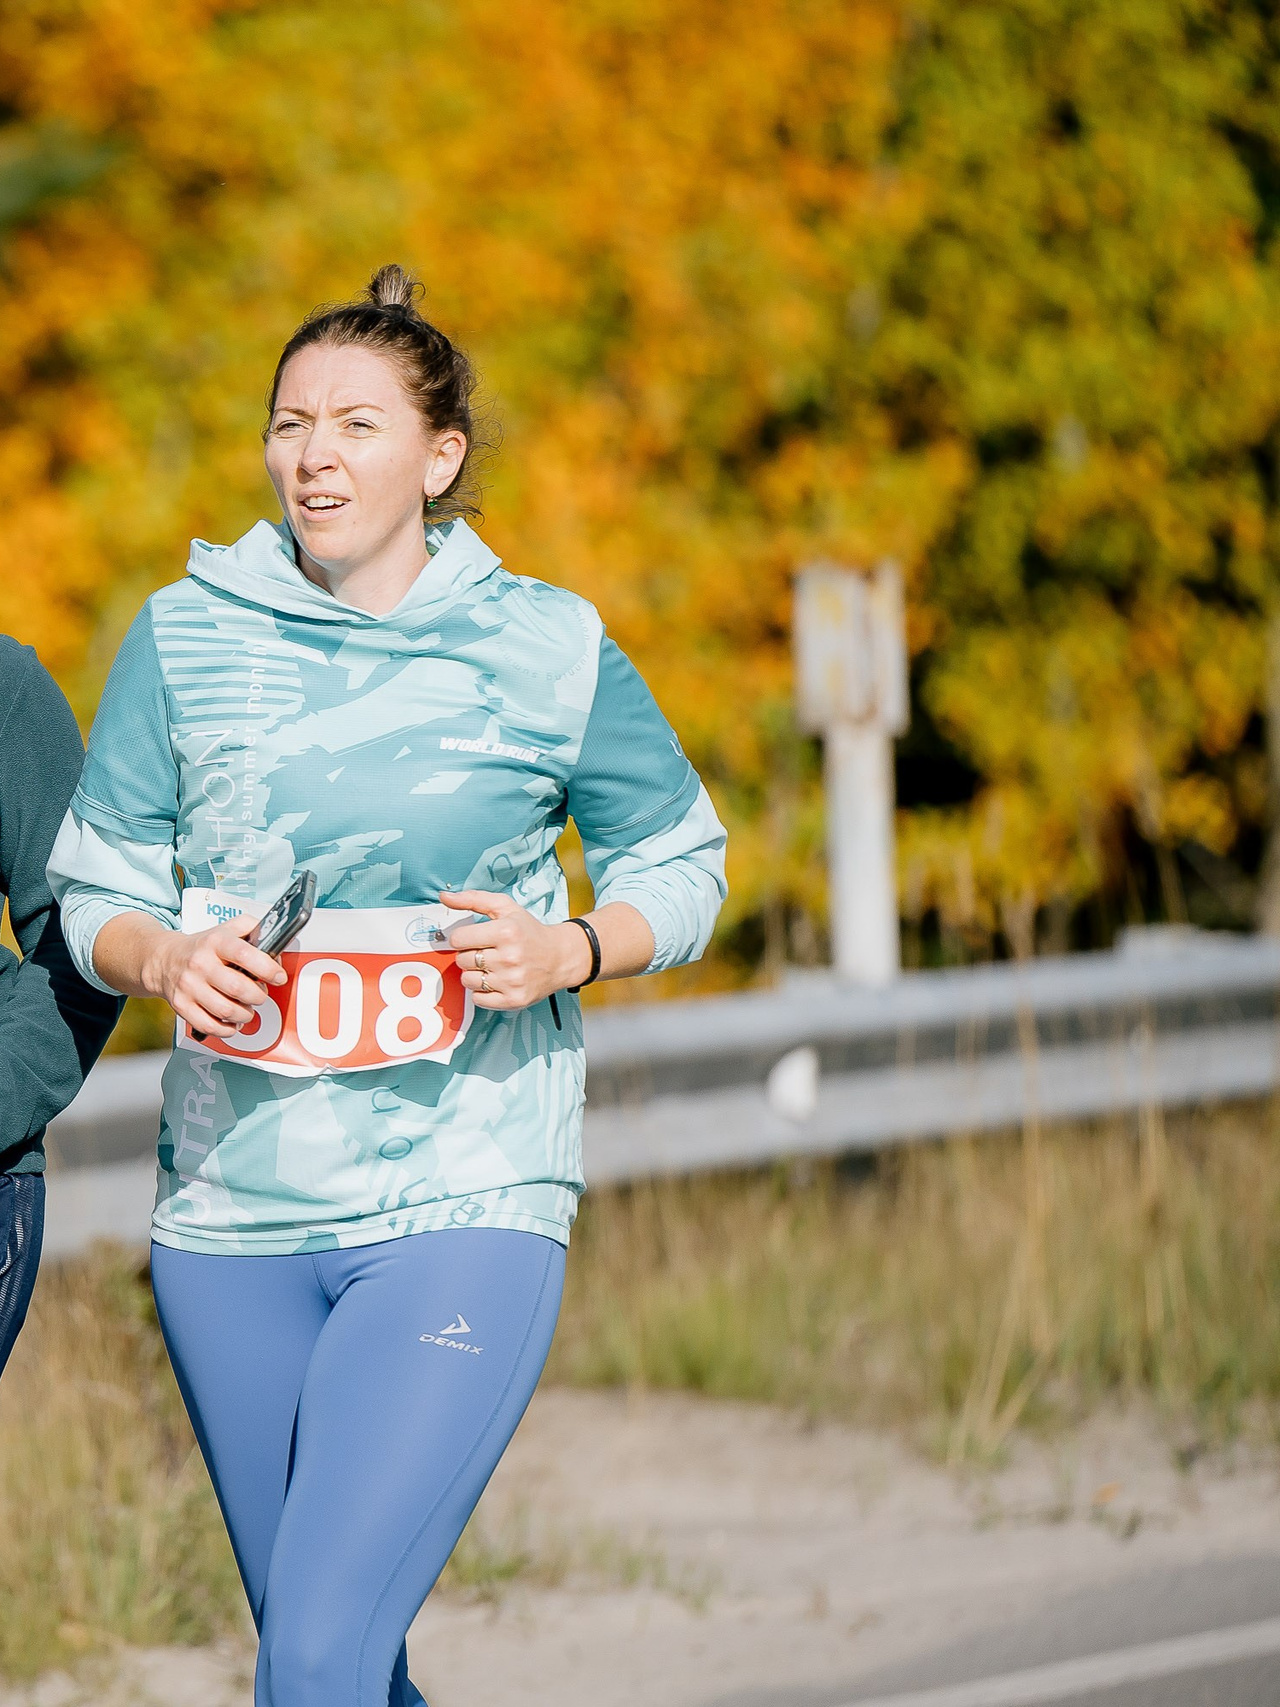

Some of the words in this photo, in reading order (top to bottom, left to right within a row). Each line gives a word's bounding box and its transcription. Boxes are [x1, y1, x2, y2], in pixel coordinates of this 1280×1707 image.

[544, 651, 591, 681] running
[241, 725, 258, 821] summer
[418, 1333, 484, 1355] DEMIX
